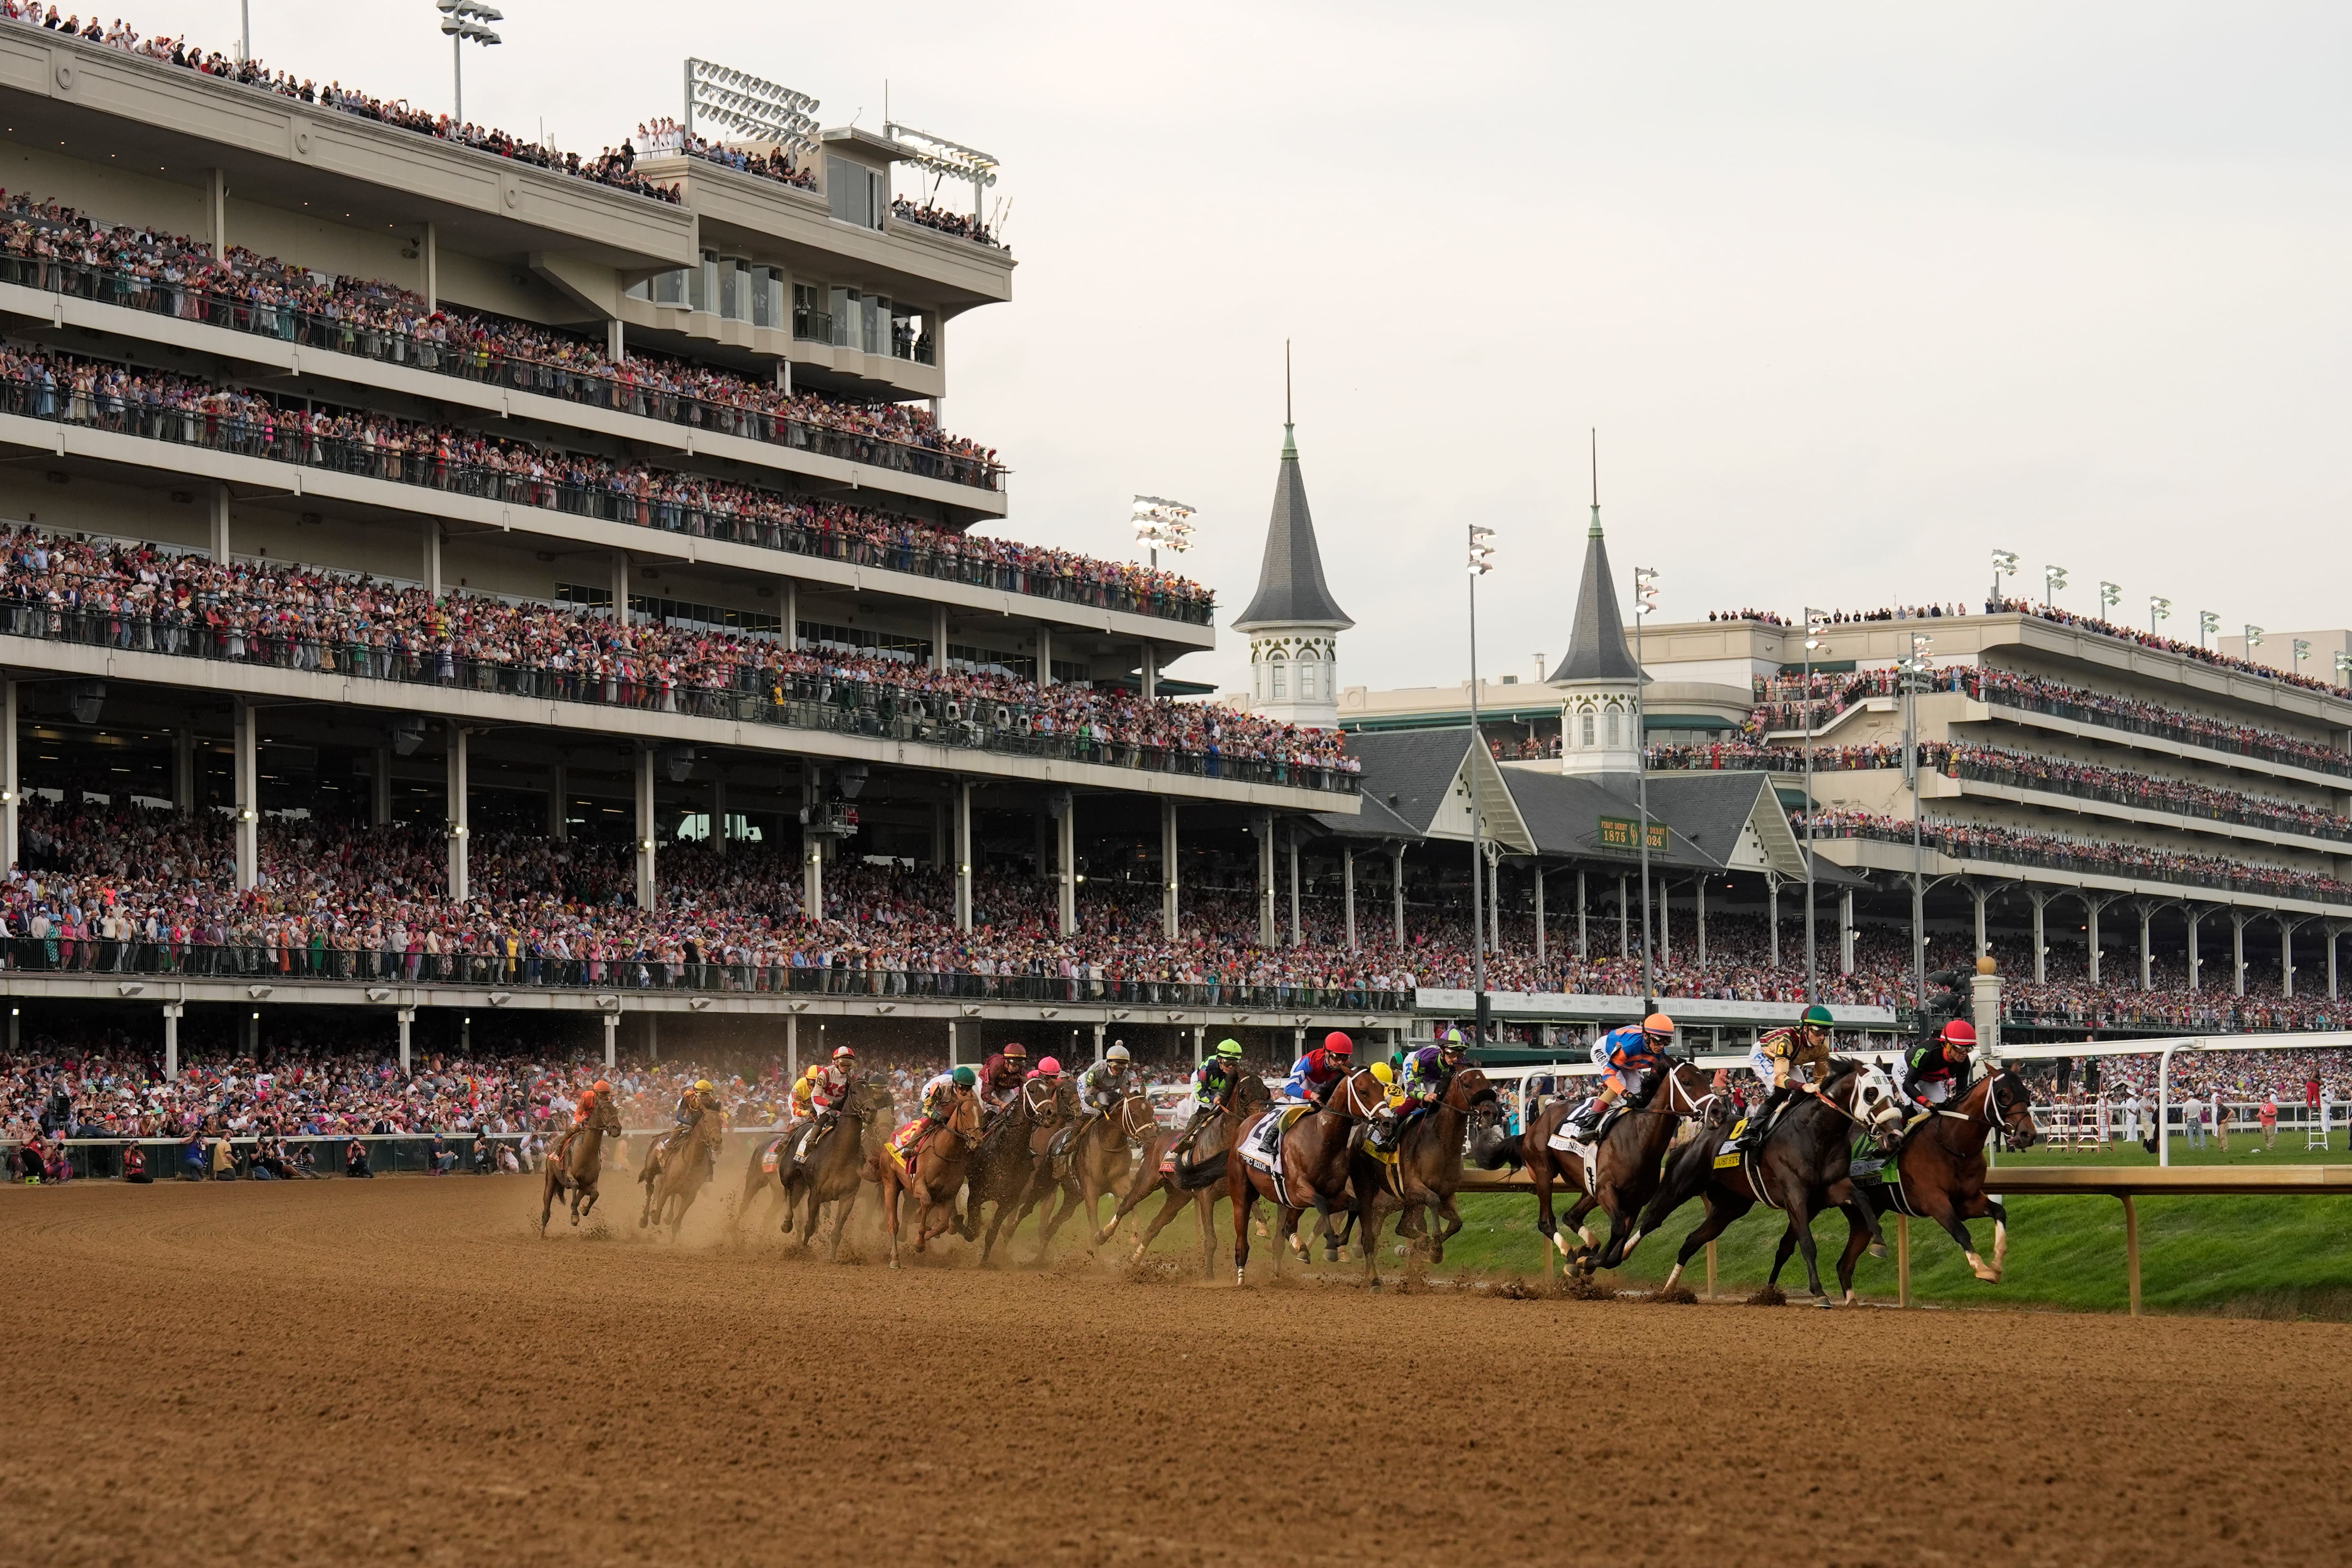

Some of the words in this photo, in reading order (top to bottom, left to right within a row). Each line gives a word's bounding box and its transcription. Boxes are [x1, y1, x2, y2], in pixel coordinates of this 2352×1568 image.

[1614, 822, 1628, 831] DERBY
[1650, 827, 1665, 836] DERBY
[1604, 830, 1626, 843] 1875
[1646, 835, 1662, 847] 024
[1679, 1002, 1694, 1012] DOWNS
[1777, 1042, 1785, 1055] 6
[817, 1076, 823, 1086] 15
[1087, 1073, 1094, 1083] 5
[1240, 1154, 1253, 1165] PIC
[1253, 1160, 1267, 1172] RIDE
